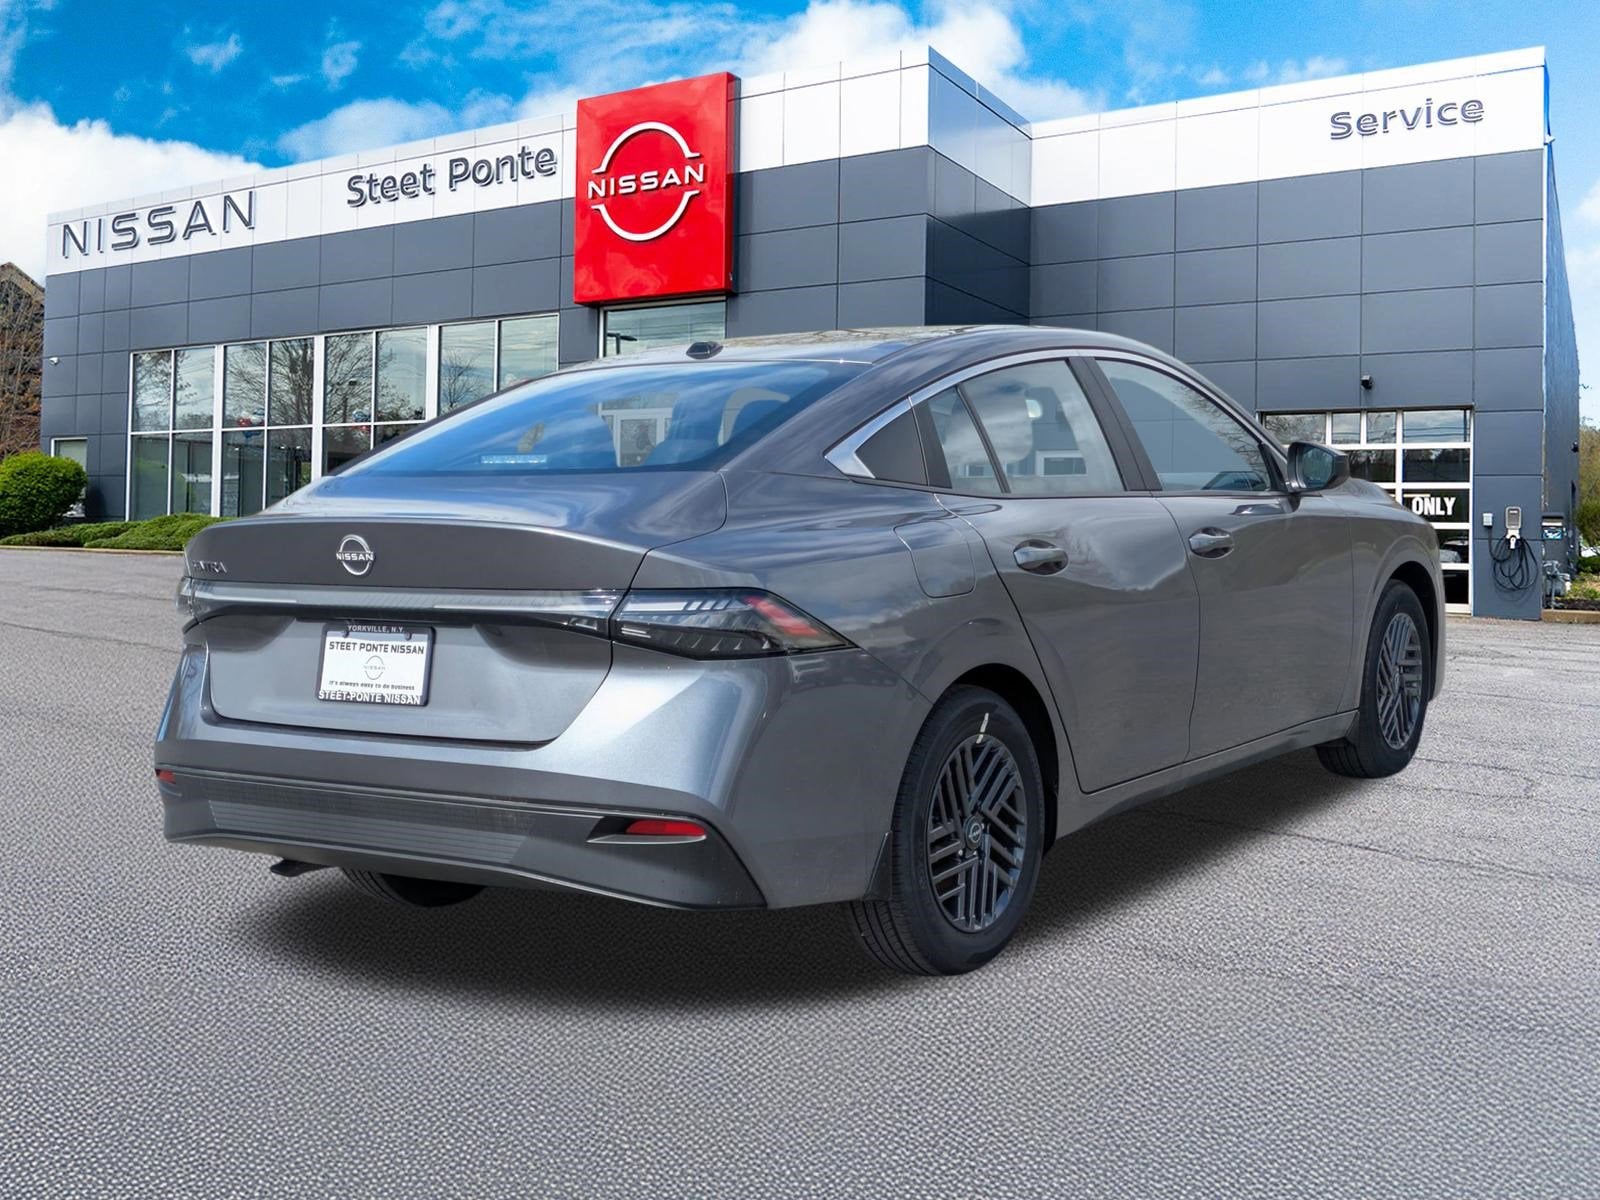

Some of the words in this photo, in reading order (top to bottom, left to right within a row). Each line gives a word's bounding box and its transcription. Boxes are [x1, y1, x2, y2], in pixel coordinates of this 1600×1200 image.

[1330, 98, 1485, 140] Service
[347, 163, 436, 208] Steet
[449, 145, 558, 191] Ponte
[587, 163, 704, 199] NISSAN
[62, 190, 256, 259] NISSAN
[1411, 496, 1456, 516] ONLY
[336, 551, 374, 561] NISSAN
[329, 641, 357, 651] STEET
[359, 642, 389, 653] PONTE
[390, 644, 425, 655] NISSAN
[384, 693, 421, 705] NISSAN
